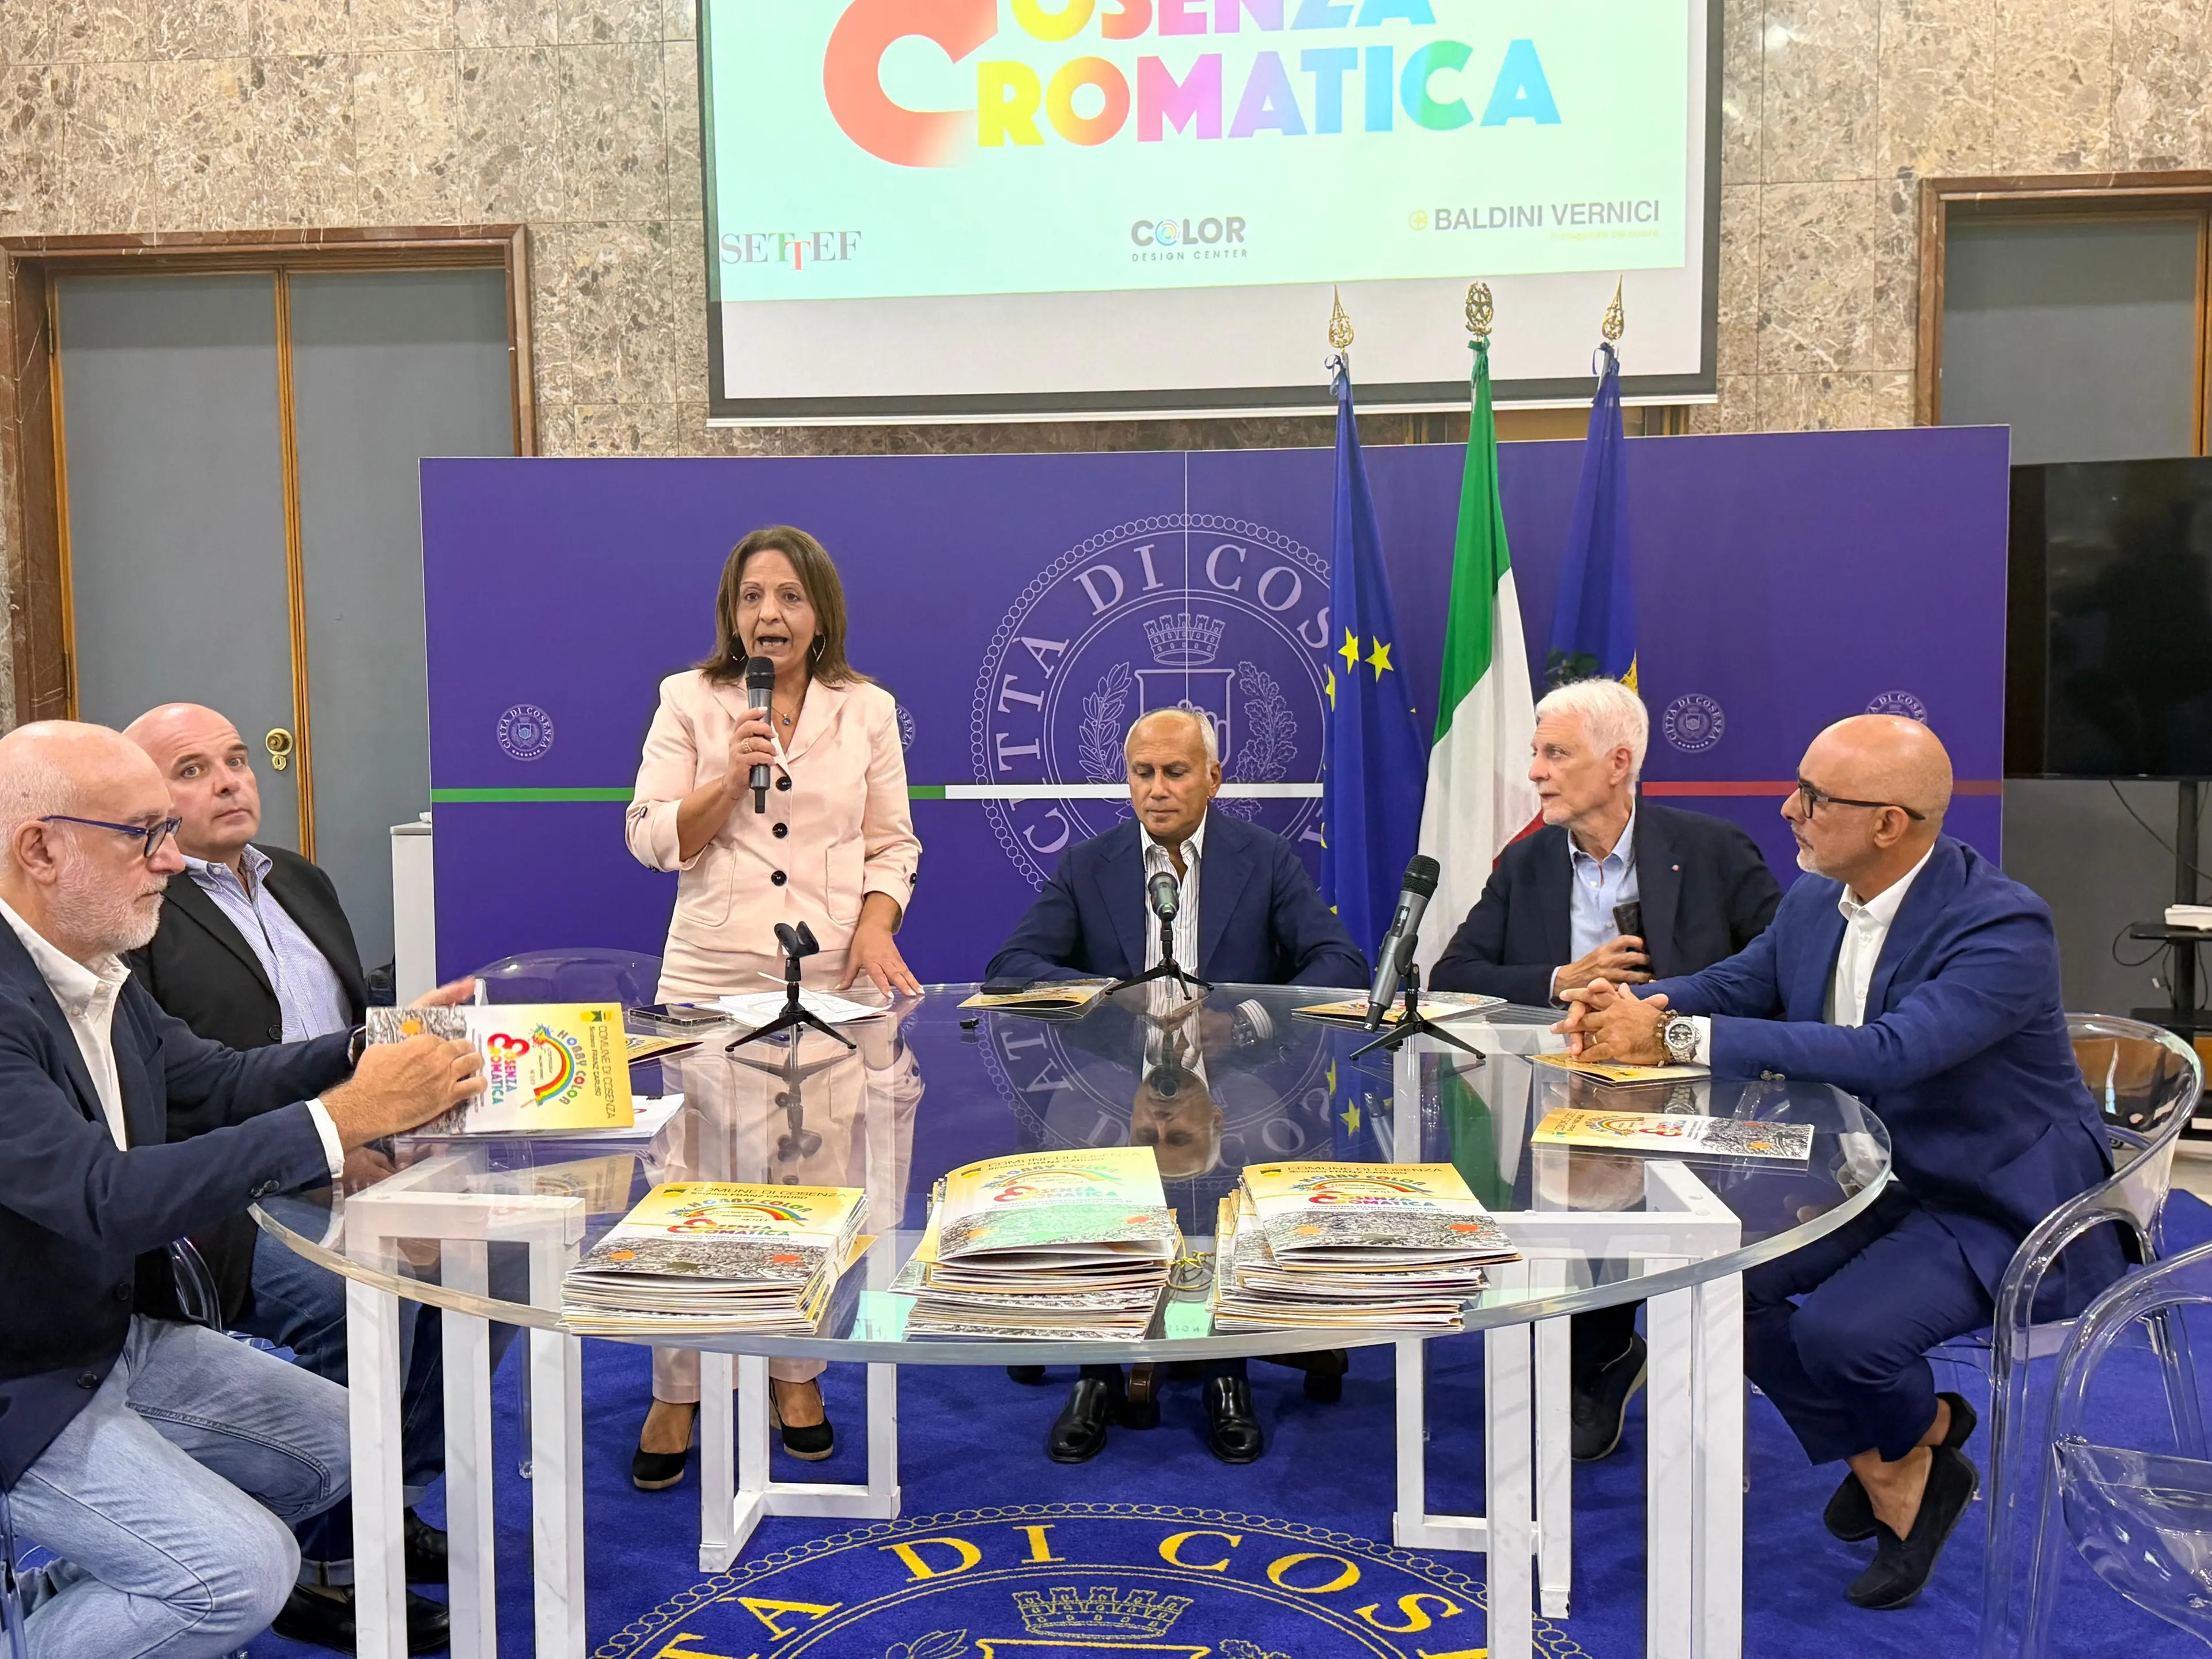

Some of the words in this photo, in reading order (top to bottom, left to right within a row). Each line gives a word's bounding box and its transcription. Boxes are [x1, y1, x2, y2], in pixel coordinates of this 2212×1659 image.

[1131, 217, 1246, 247] COLOR
[1434, 205, 1543, 230] BALDINI
[1551, 200, 1659, 226] VERNICI
[721, 231, 861, 270] SETTEF
[1132, 252, 1184, 262] DESIGN
[1194, 249, 1248, 259] CENTER
[996, 636, 1070, 854] CTTÀ
[1073, 544, 1165, 616] DI
[1878, 694, 1892, 704] DI
[510, 707, 522, 718] DI
[527, 707, 552, 748] COSENZA
[896, 707, 912, 745] OSENZA
[1677, 696, 1691, 707] DI
[1696, 696, 1722, 740] COSENZA
[558, 1029, 588, 1066] HOBBY
[559, 1070, 587, 1105] COLOR
[878, 1524, 1066, 1583] DI
